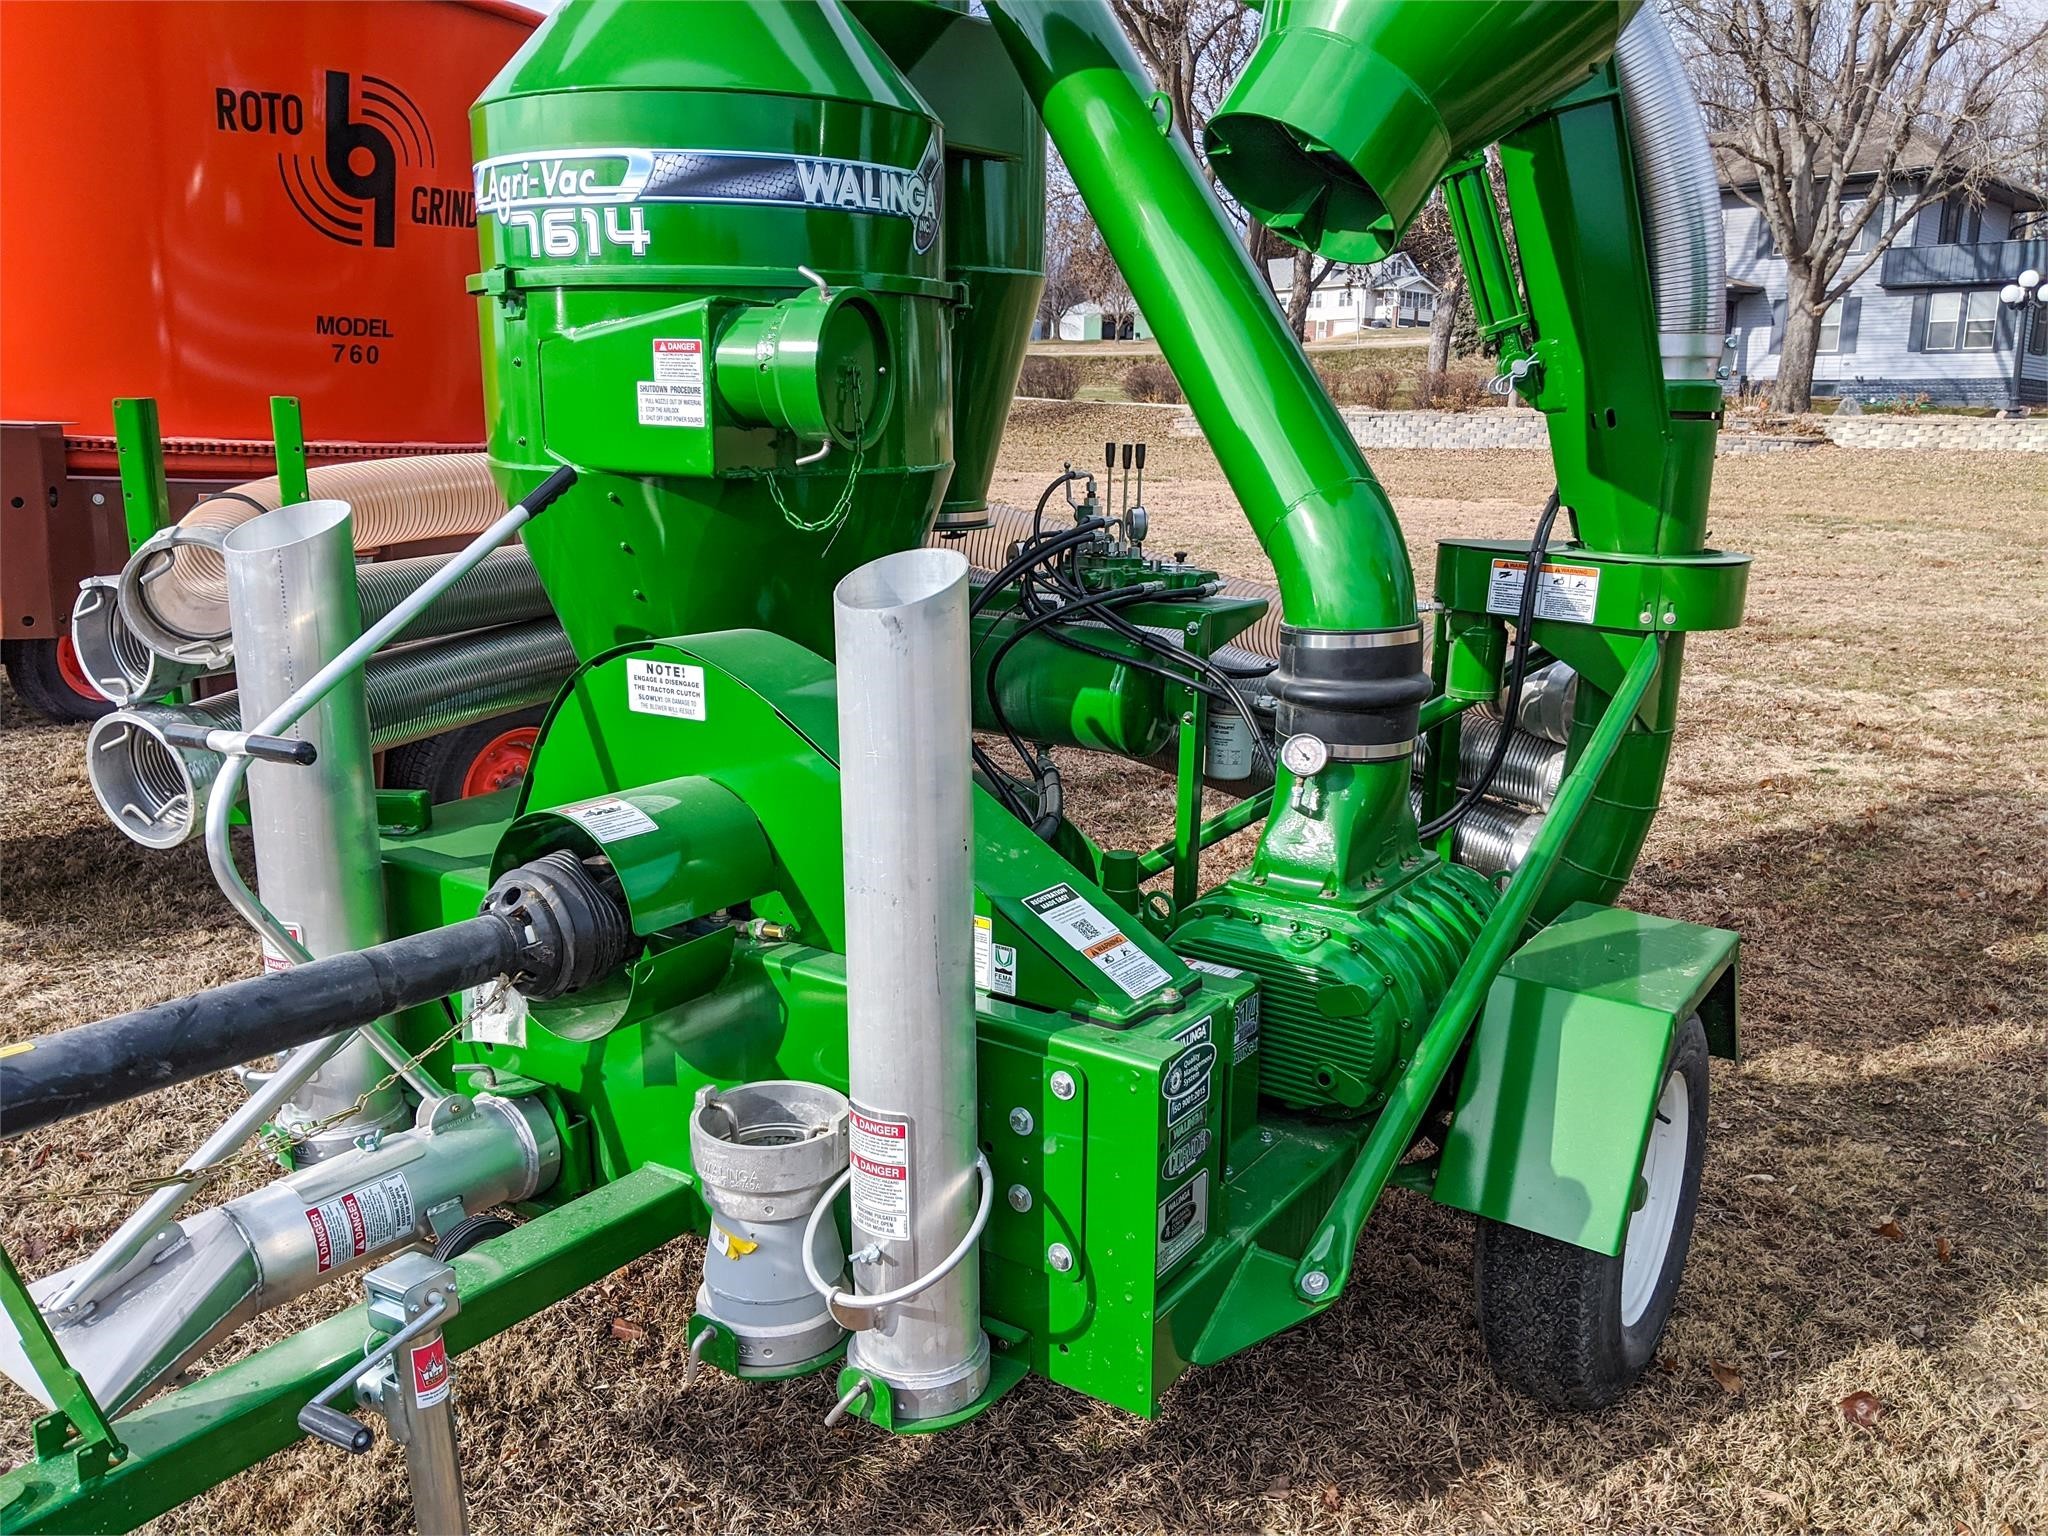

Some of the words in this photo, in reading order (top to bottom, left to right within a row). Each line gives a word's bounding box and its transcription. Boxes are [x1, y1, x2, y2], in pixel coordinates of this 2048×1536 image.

[216, 87, 303, 135] ROTO
[489, 160, 596, 224] Agri-Vac
[794, 158, 937, 221] WALINGA
[510, 207, 650, 258] 7614
[316, 315, 394, 338] MODEL
[331, 343, 379, 364] 760
[667, 342, 696, 351] DANGER
[640, 384, 668, 393] SHUTDOWN
[669, 385, 702, 395] PROCEDURE
[1560, 567, 1588, 575] WARNING
[646, 662, 686, 679] NOTE!
[634, 674, 658, 684] ENGAGE
[665, 678, 700, 689] DISENGAGE
[634, 683, 646, 691] THE
[646, 685, 675, 695] TRACTOR
[676, 690, 700, 698] CLUTCH
[1030, 886, 1068, 906] REGISTRATION
[1098, 936, 1123, 953] WARNING
[994, 972, 1013, 983] FEMA
[1183, 1052, 1201, 1068] Quality
[1183, 1053, 1213, 1077] Management
[1183, 1071, 1200, 1087] System
[860, 1118, 899, 1136] DANGER
[1172, 1110, 1204, 1140] WALINGA
[703, 1159, 758, 1183] WALINGA
[860, 1160, 900, 1178] DANGER
[346, 1198, 364, 1238] DANGER
[873, 1213, 897, 1222] PULSATES
[880, 1219, 893, 1227] OPEN
[310, 1212, 330, 1255] DANGER
